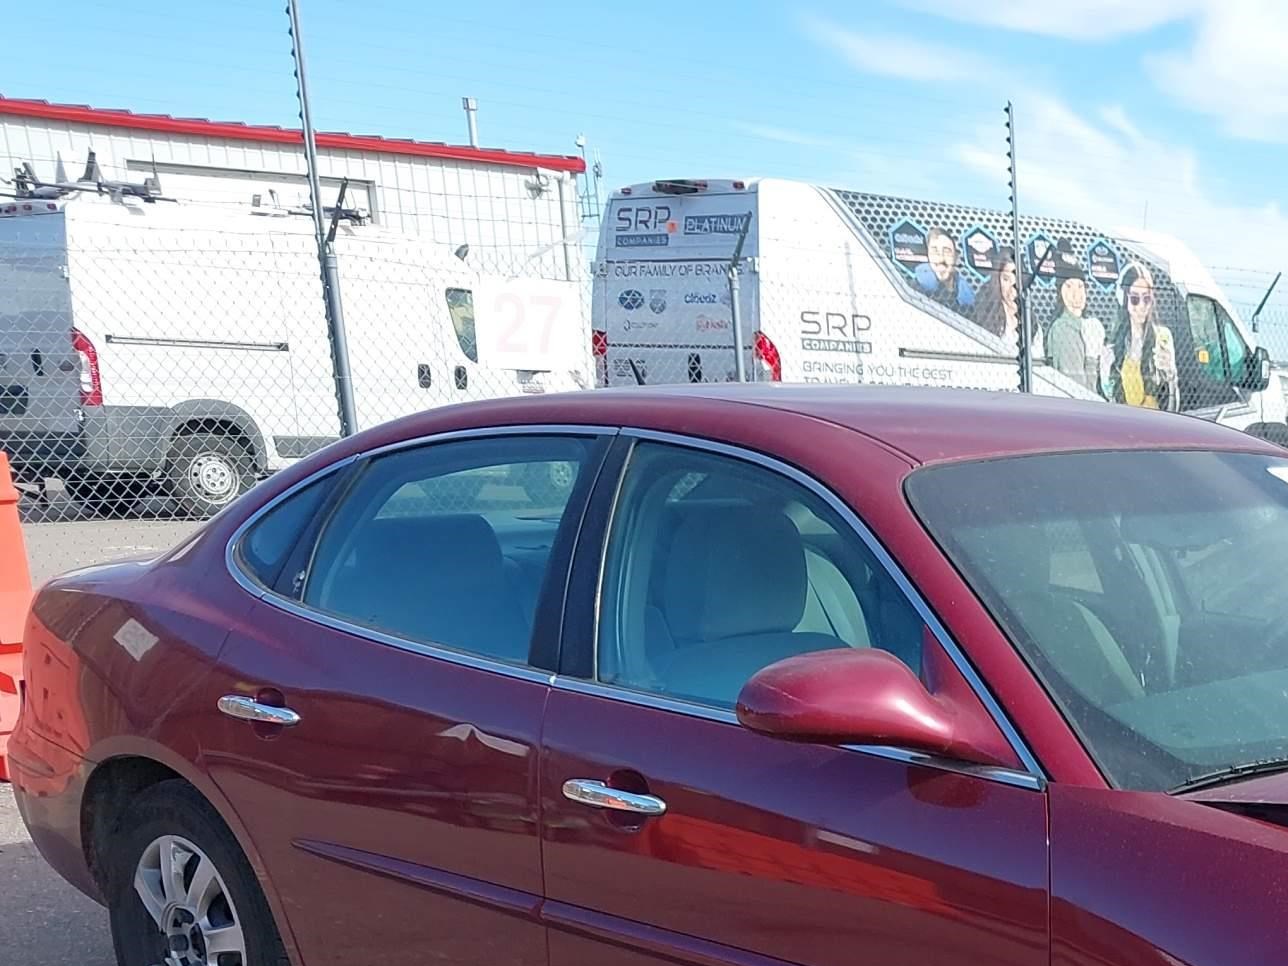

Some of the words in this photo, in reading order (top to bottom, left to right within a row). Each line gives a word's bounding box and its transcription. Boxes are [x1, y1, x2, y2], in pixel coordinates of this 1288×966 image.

[616, 206, 671, 231] SRP
[686, 216, 747, 233] PLATINUM
[617, 236, 668, 246] COMPANIES
[615, 265, 638, 277] OUR
[639, 264, 677, 277] FAMILY
[679, 264, 694, 276] OF
[695, 263, 744, 276] BRANS
[494, 292, 562, 354] 27
[801, 311, 871, 337] SRP
[803, 361, 864, 376] BRINGING
[867, 364, 894, 377] YOU
[898, 366, 921, 378] THE
[922, 367, 953, 380] BEST
